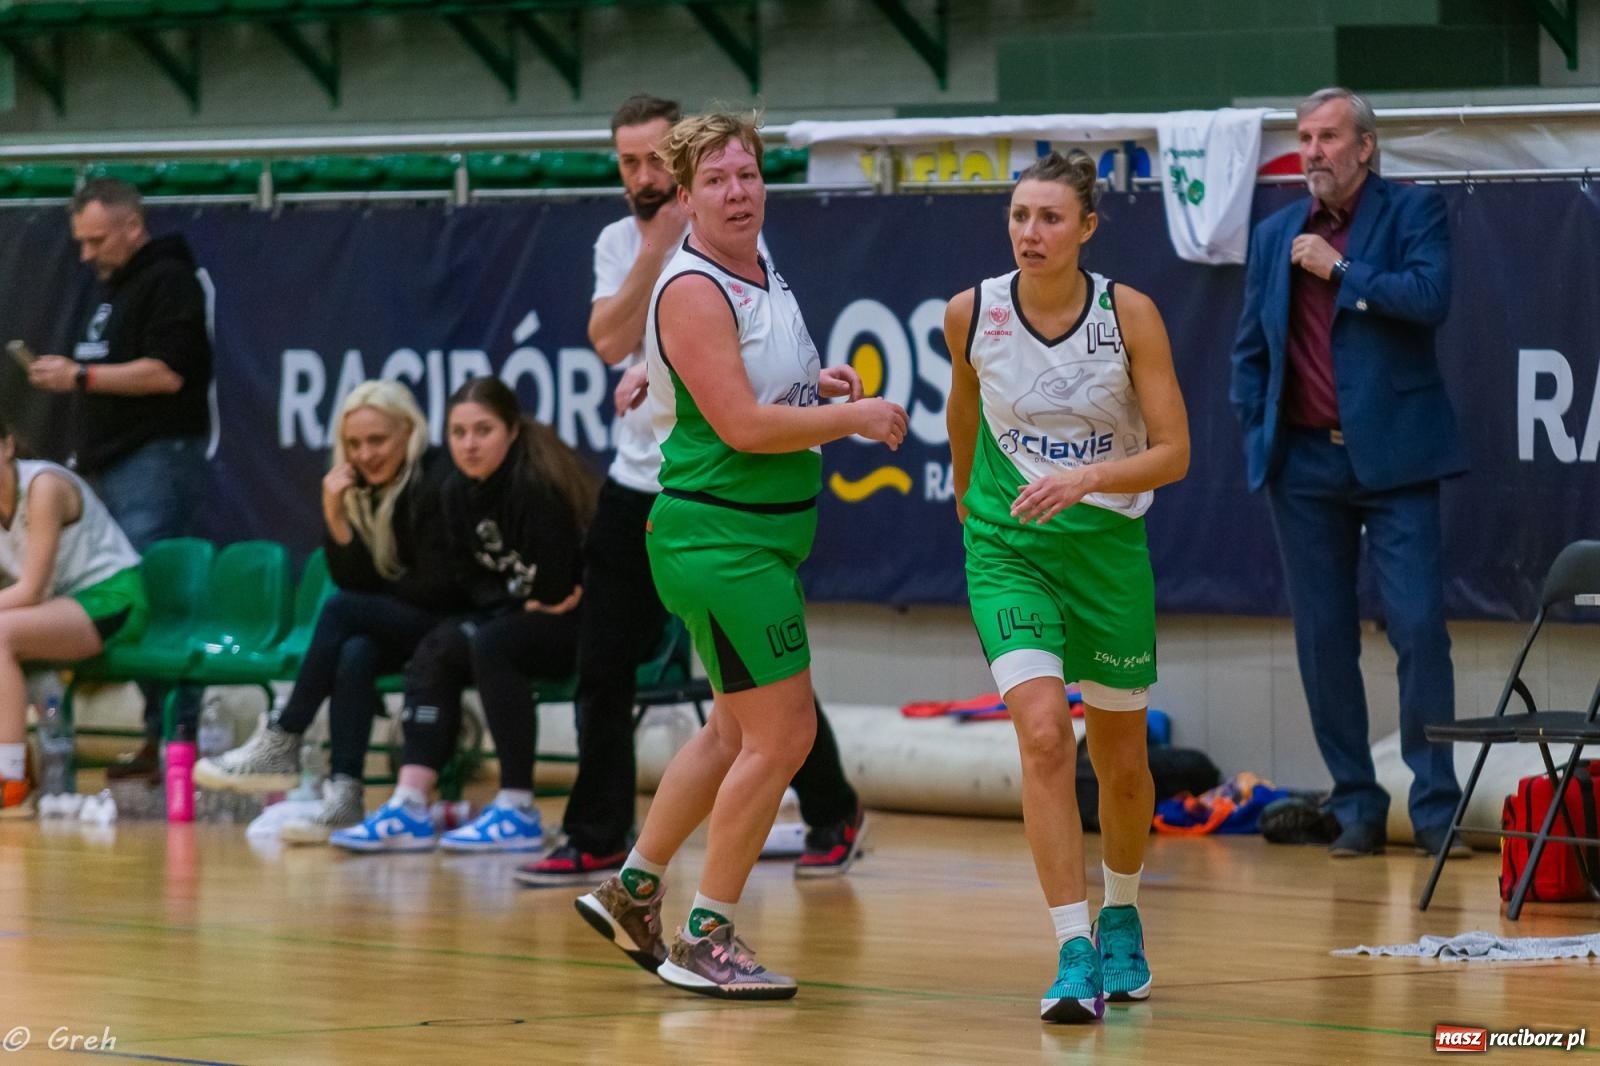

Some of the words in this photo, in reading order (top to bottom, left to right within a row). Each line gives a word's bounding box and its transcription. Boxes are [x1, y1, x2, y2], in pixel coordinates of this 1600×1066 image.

[1087, 322, 1122, 354] 14
[1022, 430, 1114, 460] clavis
[766, 614, 807, 659] 10
[997, 606, 1043, 641] 14
